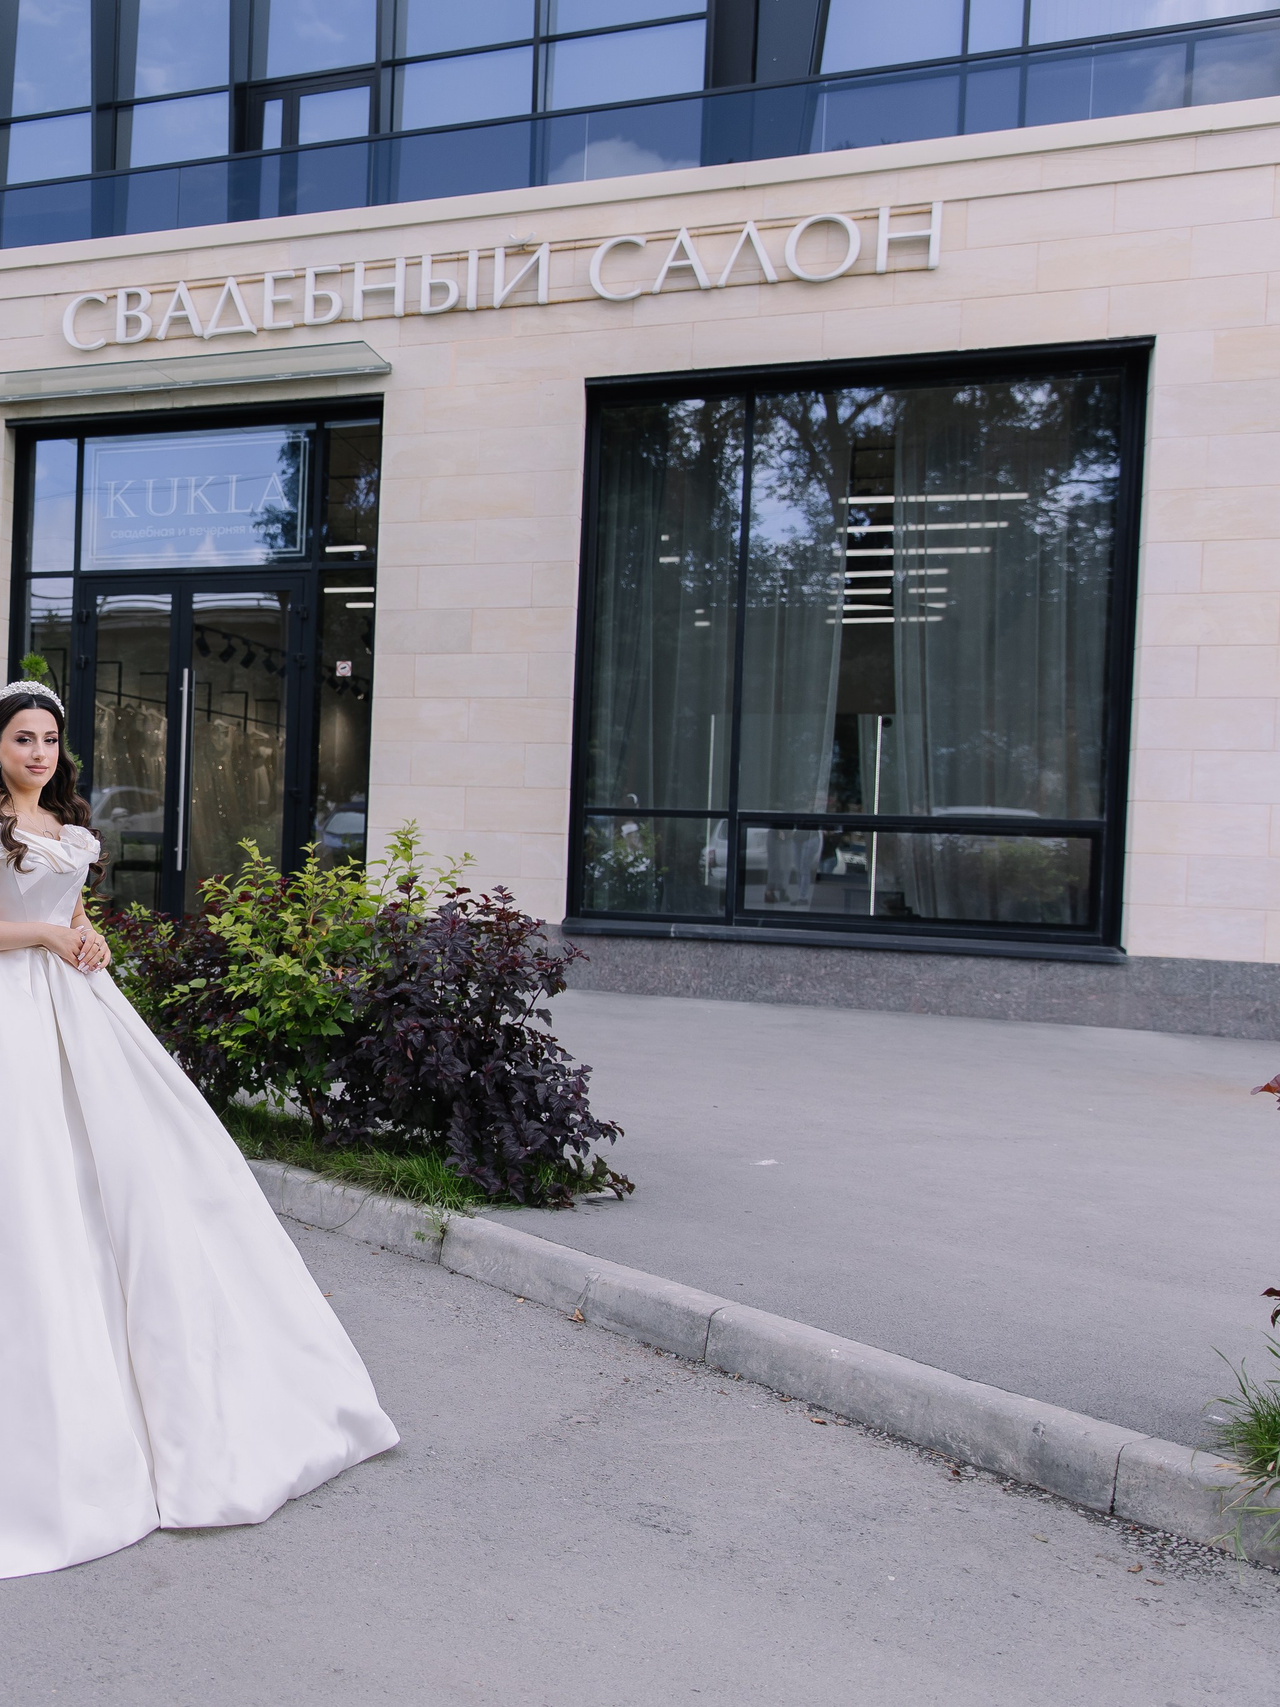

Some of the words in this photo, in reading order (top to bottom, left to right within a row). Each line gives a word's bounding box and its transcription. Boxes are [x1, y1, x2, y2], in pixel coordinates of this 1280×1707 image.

[62, 231, 550, 351] СВАДЕБНЫЙ
[589, 202, 943, 301] САЛОН
[103, 472, 297, 519] KUKLA
[110, 525, 175, 539] свадебная
[178, 528, 187, 536] и
[189, 525, 246, 538] вечерняя
